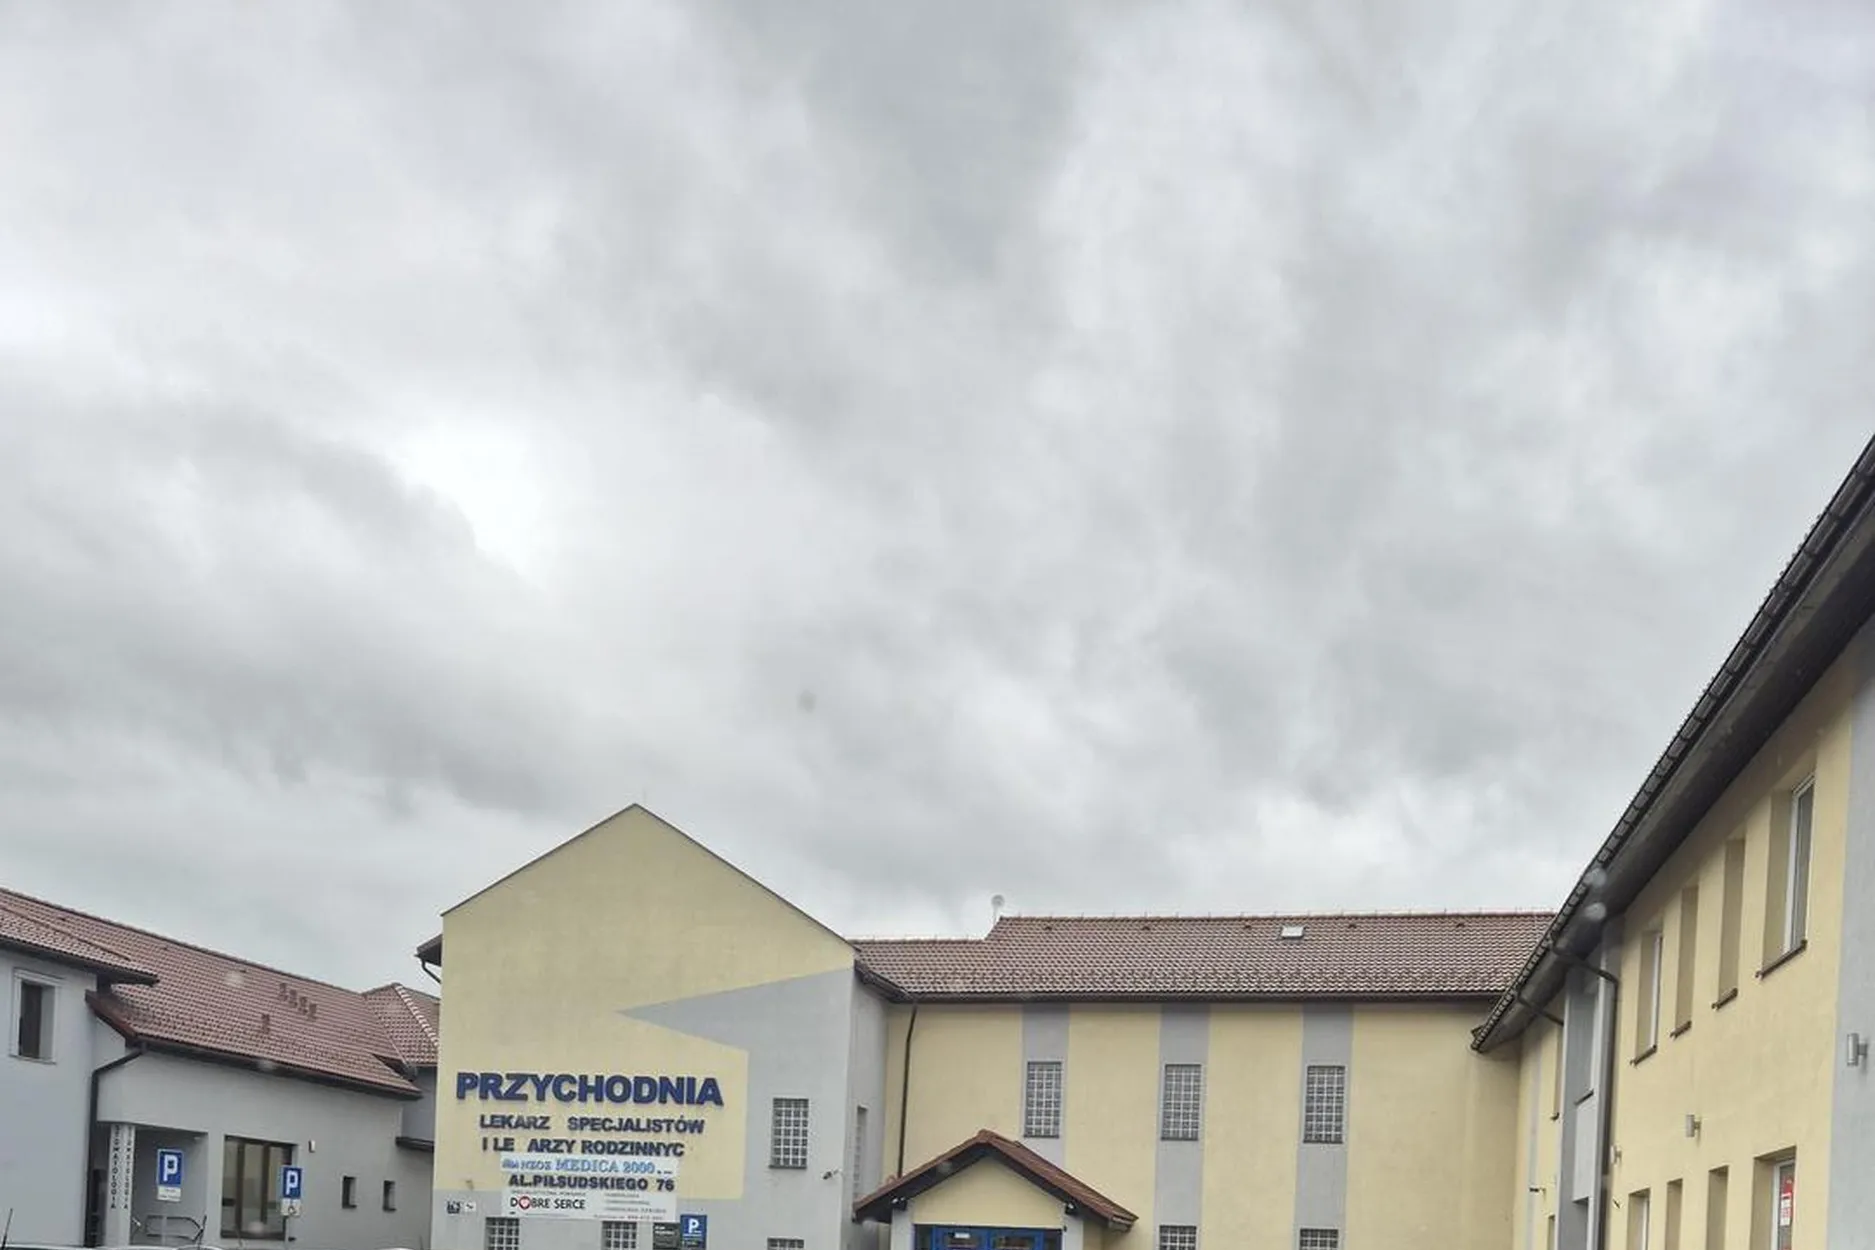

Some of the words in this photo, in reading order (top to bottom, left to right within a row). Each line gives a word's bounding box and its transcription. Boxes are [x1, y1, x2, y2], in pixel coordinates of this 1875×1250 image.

[457, 1072, 724, 1105] PRZYCHODNIA
[480, 1115, 550, 1130] LEKARZ
[567, 1115, 705, 1134] SPECJALISTÓW
[581, 1140, 685, 1157] RODZINNYC
[163, 1154, 178, 1182] P
[556, 1157, 619, 1173] MEDICA
[286, 1170, 299, 1195] P
[656, 1179, 675, 1192] 76
[510, 1196, 551, 1210] DOBRE
[555, 1199, 586, 1210] SERCE
[689, 1218, 700, 1234] P
